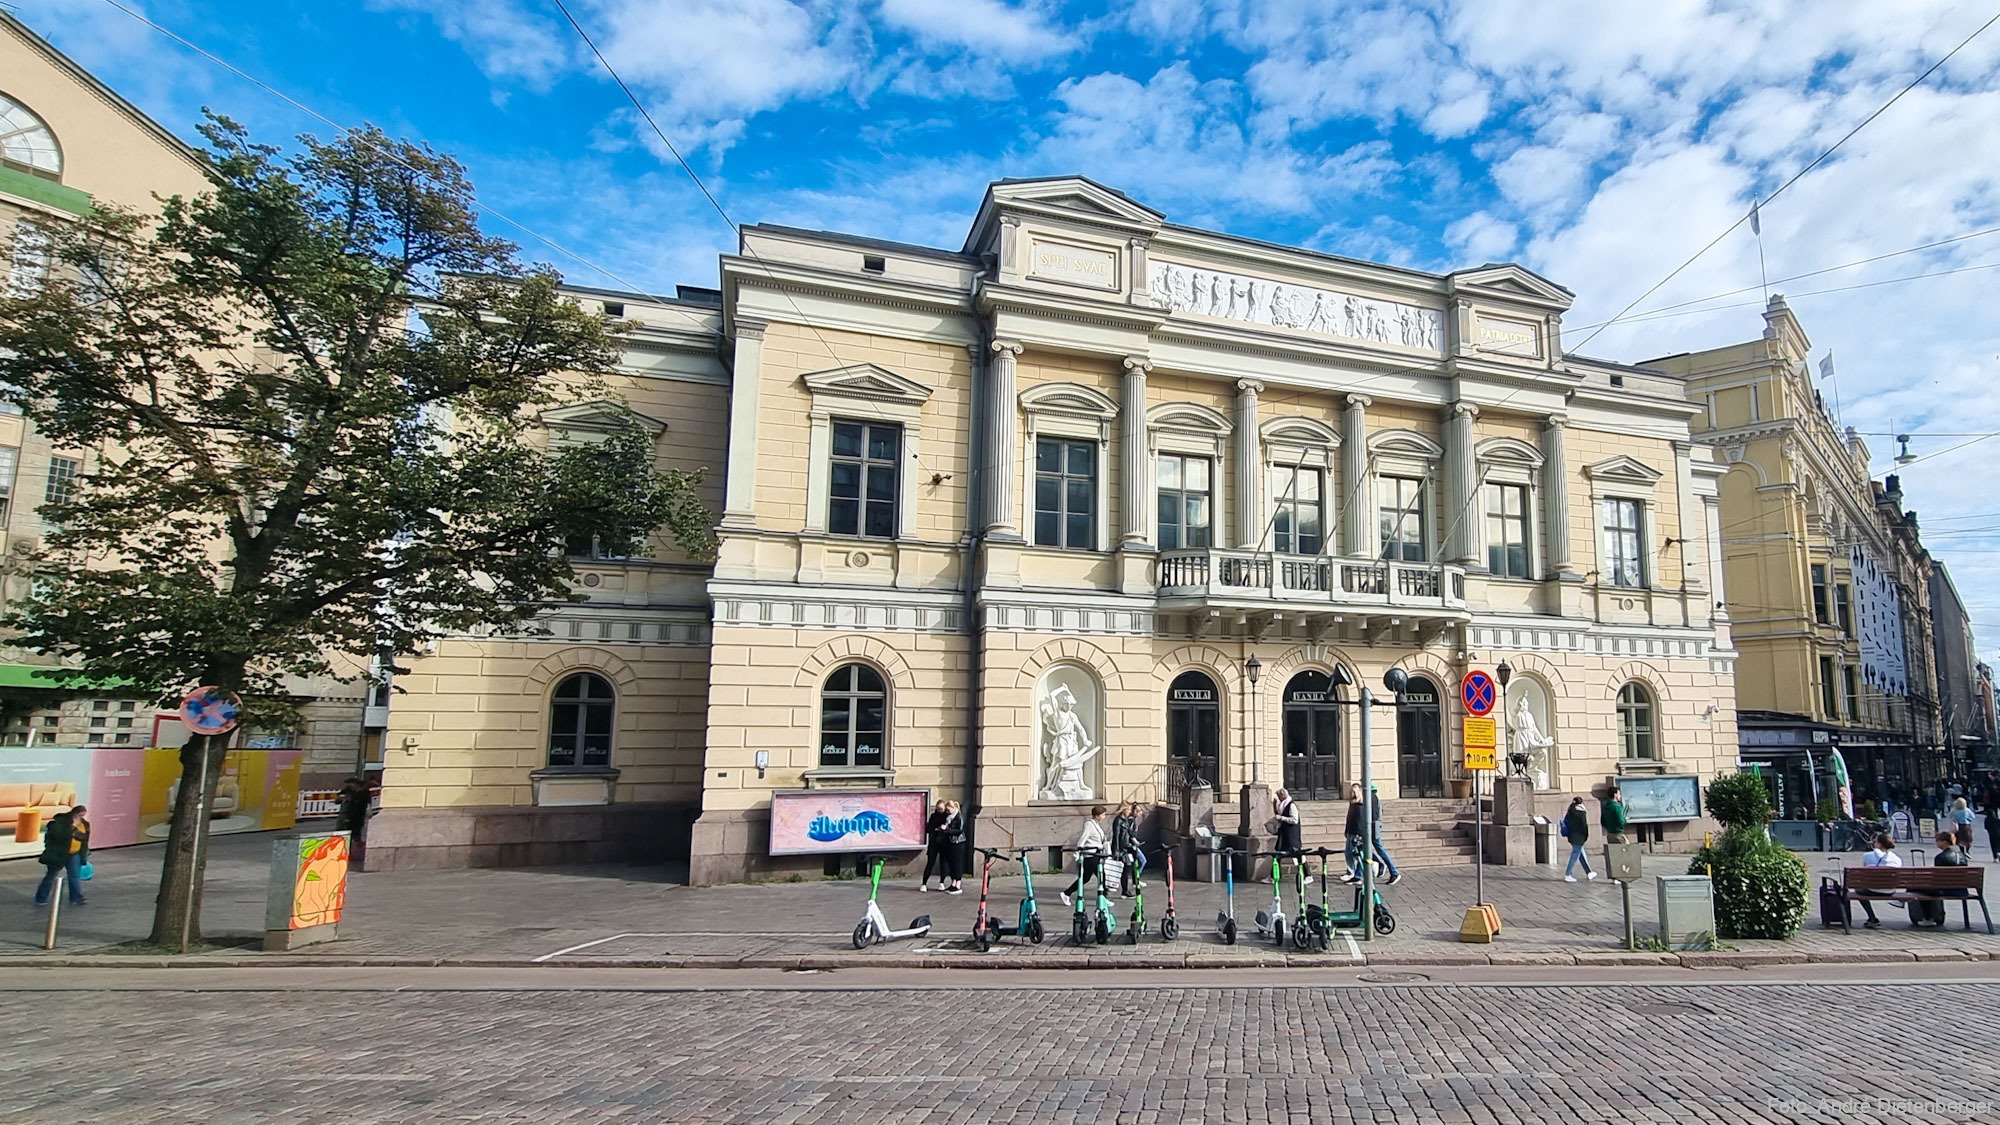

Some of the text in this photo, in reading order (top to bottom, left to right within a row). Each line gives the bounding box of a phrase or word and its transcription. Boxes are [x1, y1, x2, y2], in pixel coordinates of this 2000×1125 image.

[1176, 690, 1208, 699] VANHA
[1295, 692, 1325, 701] VANHA
[1406, 693, 1431, 702] ANHA
[1473, 754, 1481, 763] 10
